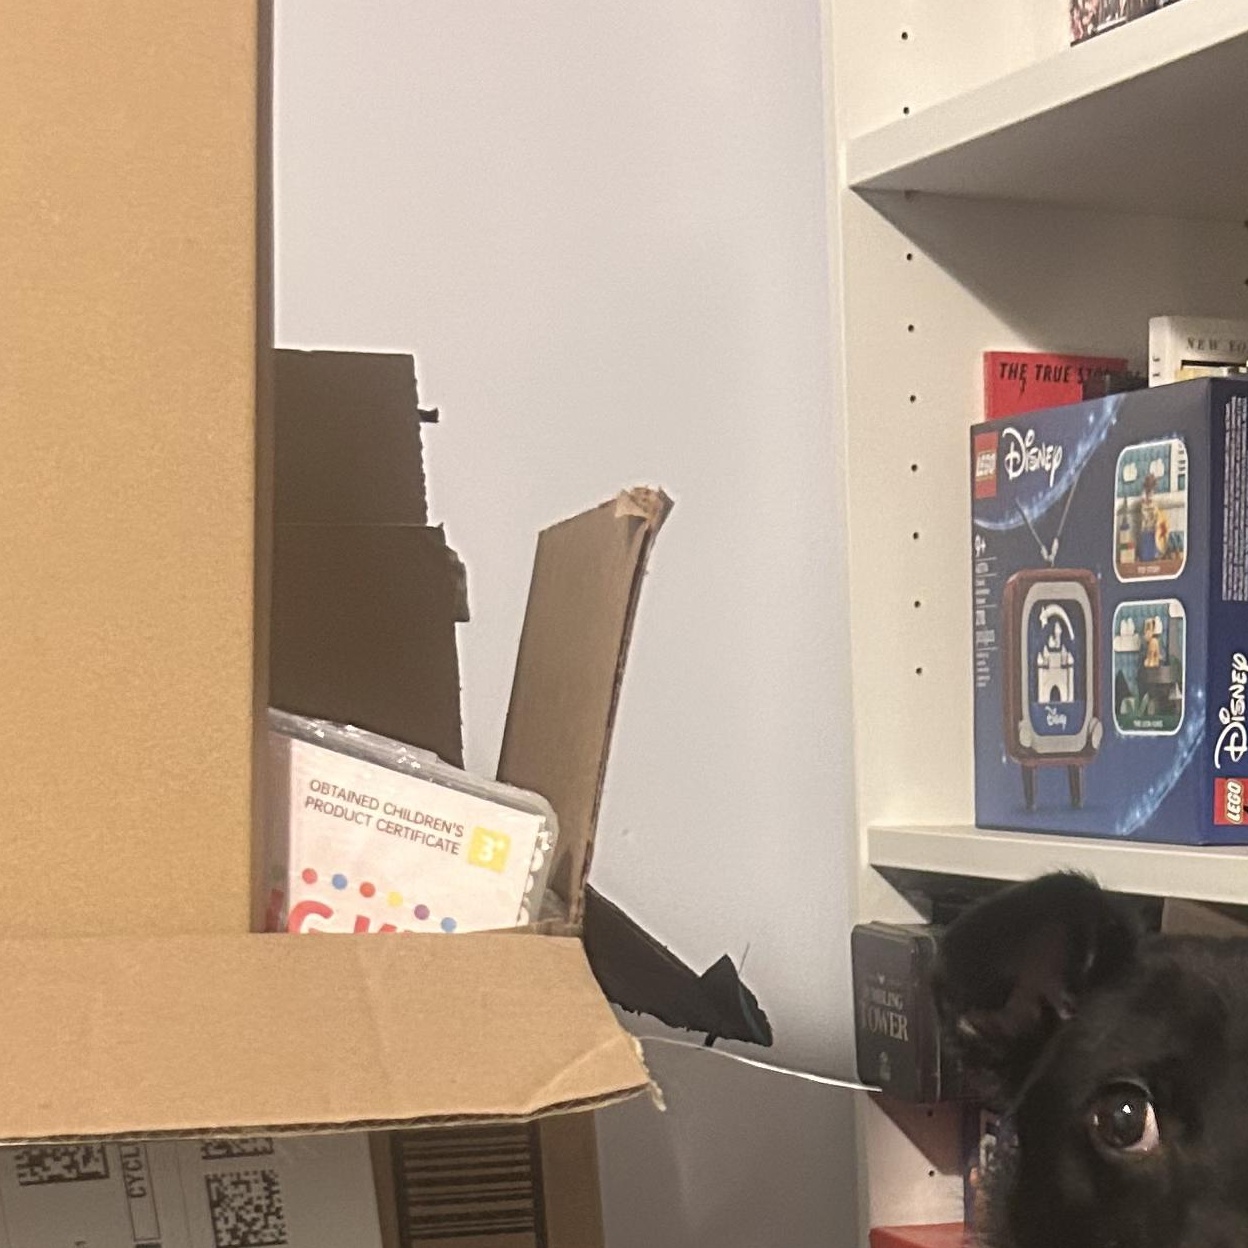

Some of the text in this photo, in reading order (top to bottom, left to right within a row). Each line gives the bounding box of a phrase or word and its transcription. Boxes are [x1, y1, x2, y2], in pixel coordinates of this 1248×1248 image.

[1000, 363, 1028, 388] THE
[1035, 364, 1070, 383] TRUE
[304, 795, 461, 855] PRODUCT CERTIFICATE
[310, 779, 465, 838] OBTAINED CHILDREN'S
[1227, 780, 1244, 824] LEGO
